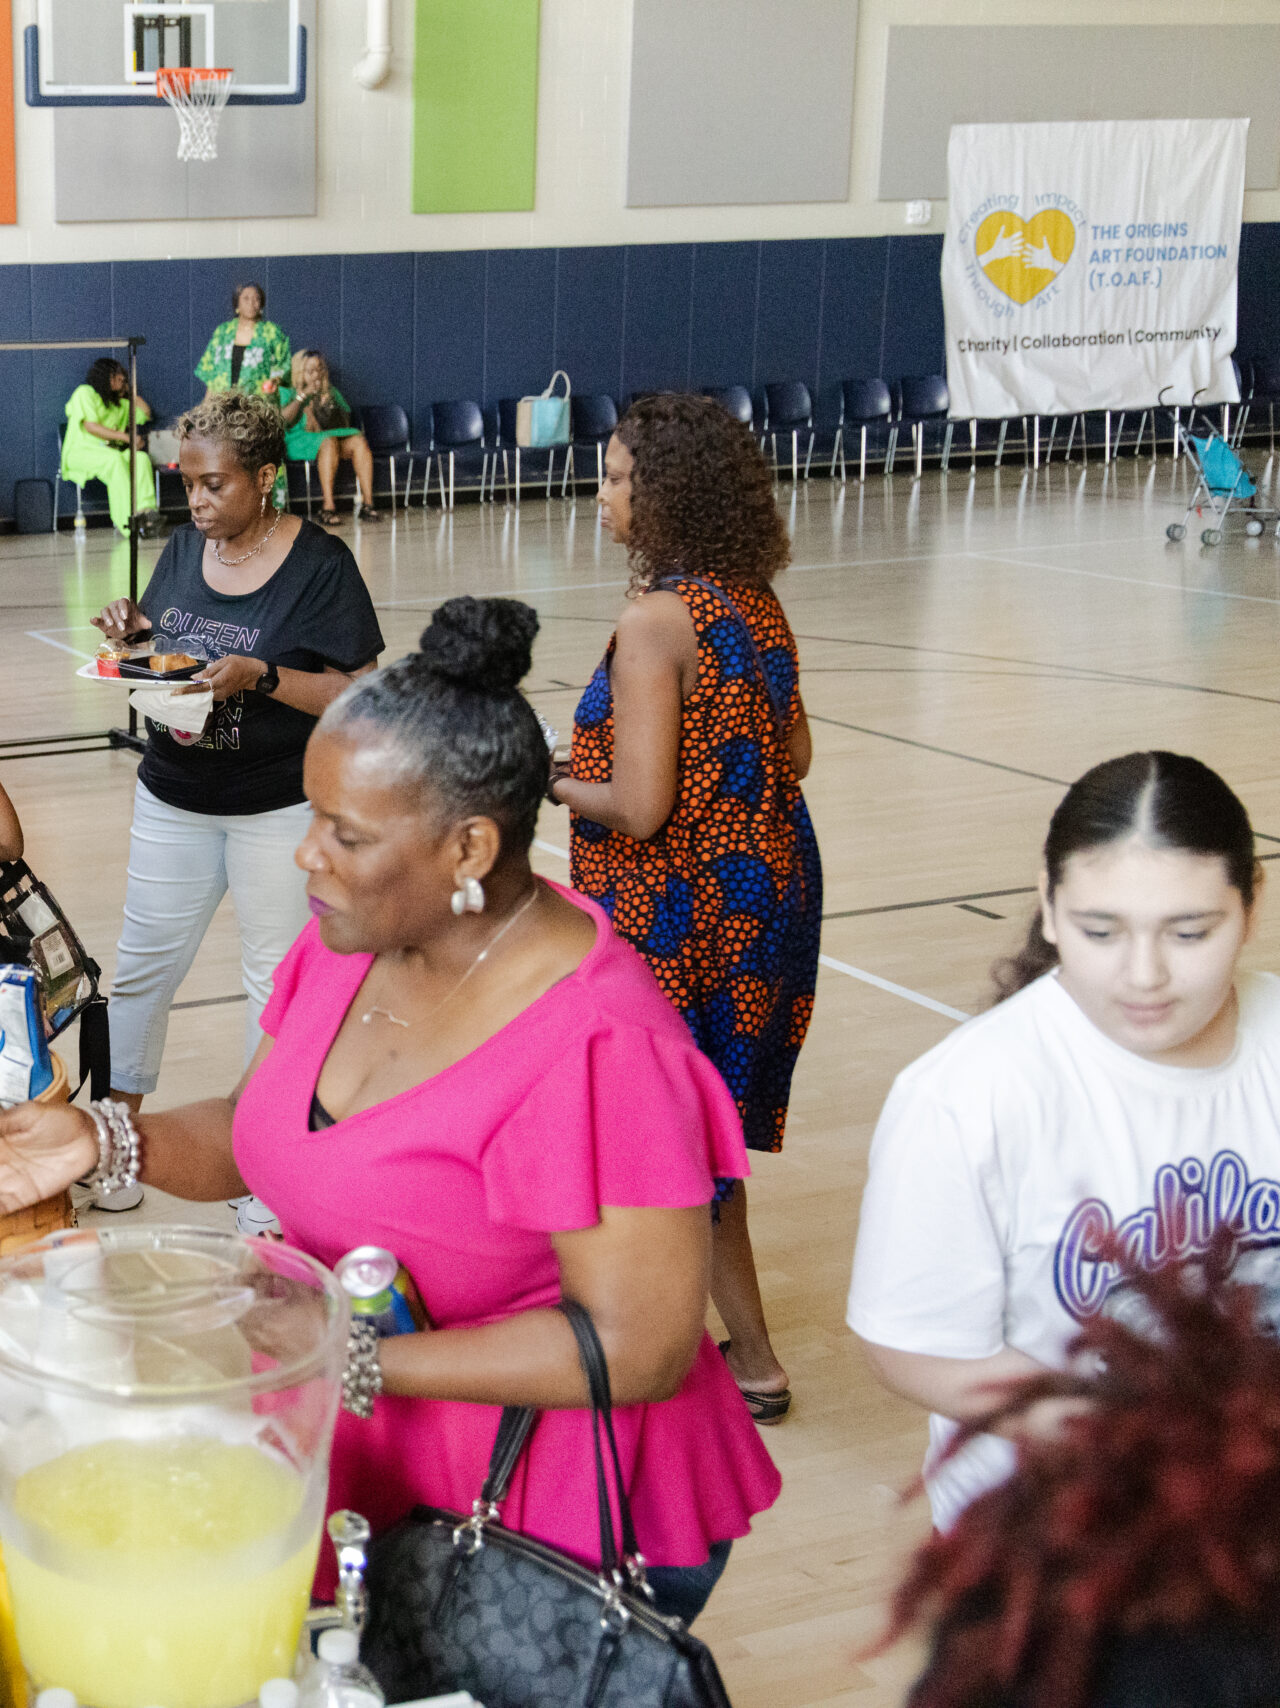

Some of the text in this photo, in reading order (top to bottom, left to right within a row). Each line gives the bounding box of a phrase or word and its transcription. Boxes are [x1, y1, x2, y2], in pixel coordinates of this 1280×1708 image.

[958, 192, 1087, 245] Creating Impact
[1091, 222, 1189, 240] THE ORIGINS
[1089, 244, 1228, 264] ART FOUNDATION
[965, 263, 1060, 318] Through Art
[1089, 267, 1162, 291] (T.O.A.F.)
[958, 338, 1011, 355] Charity
[1021, 330, 1125, 350] Collaboration
[1135, 325, 1222, 344] Community
[160, 607, 260, 652] QUEEN
